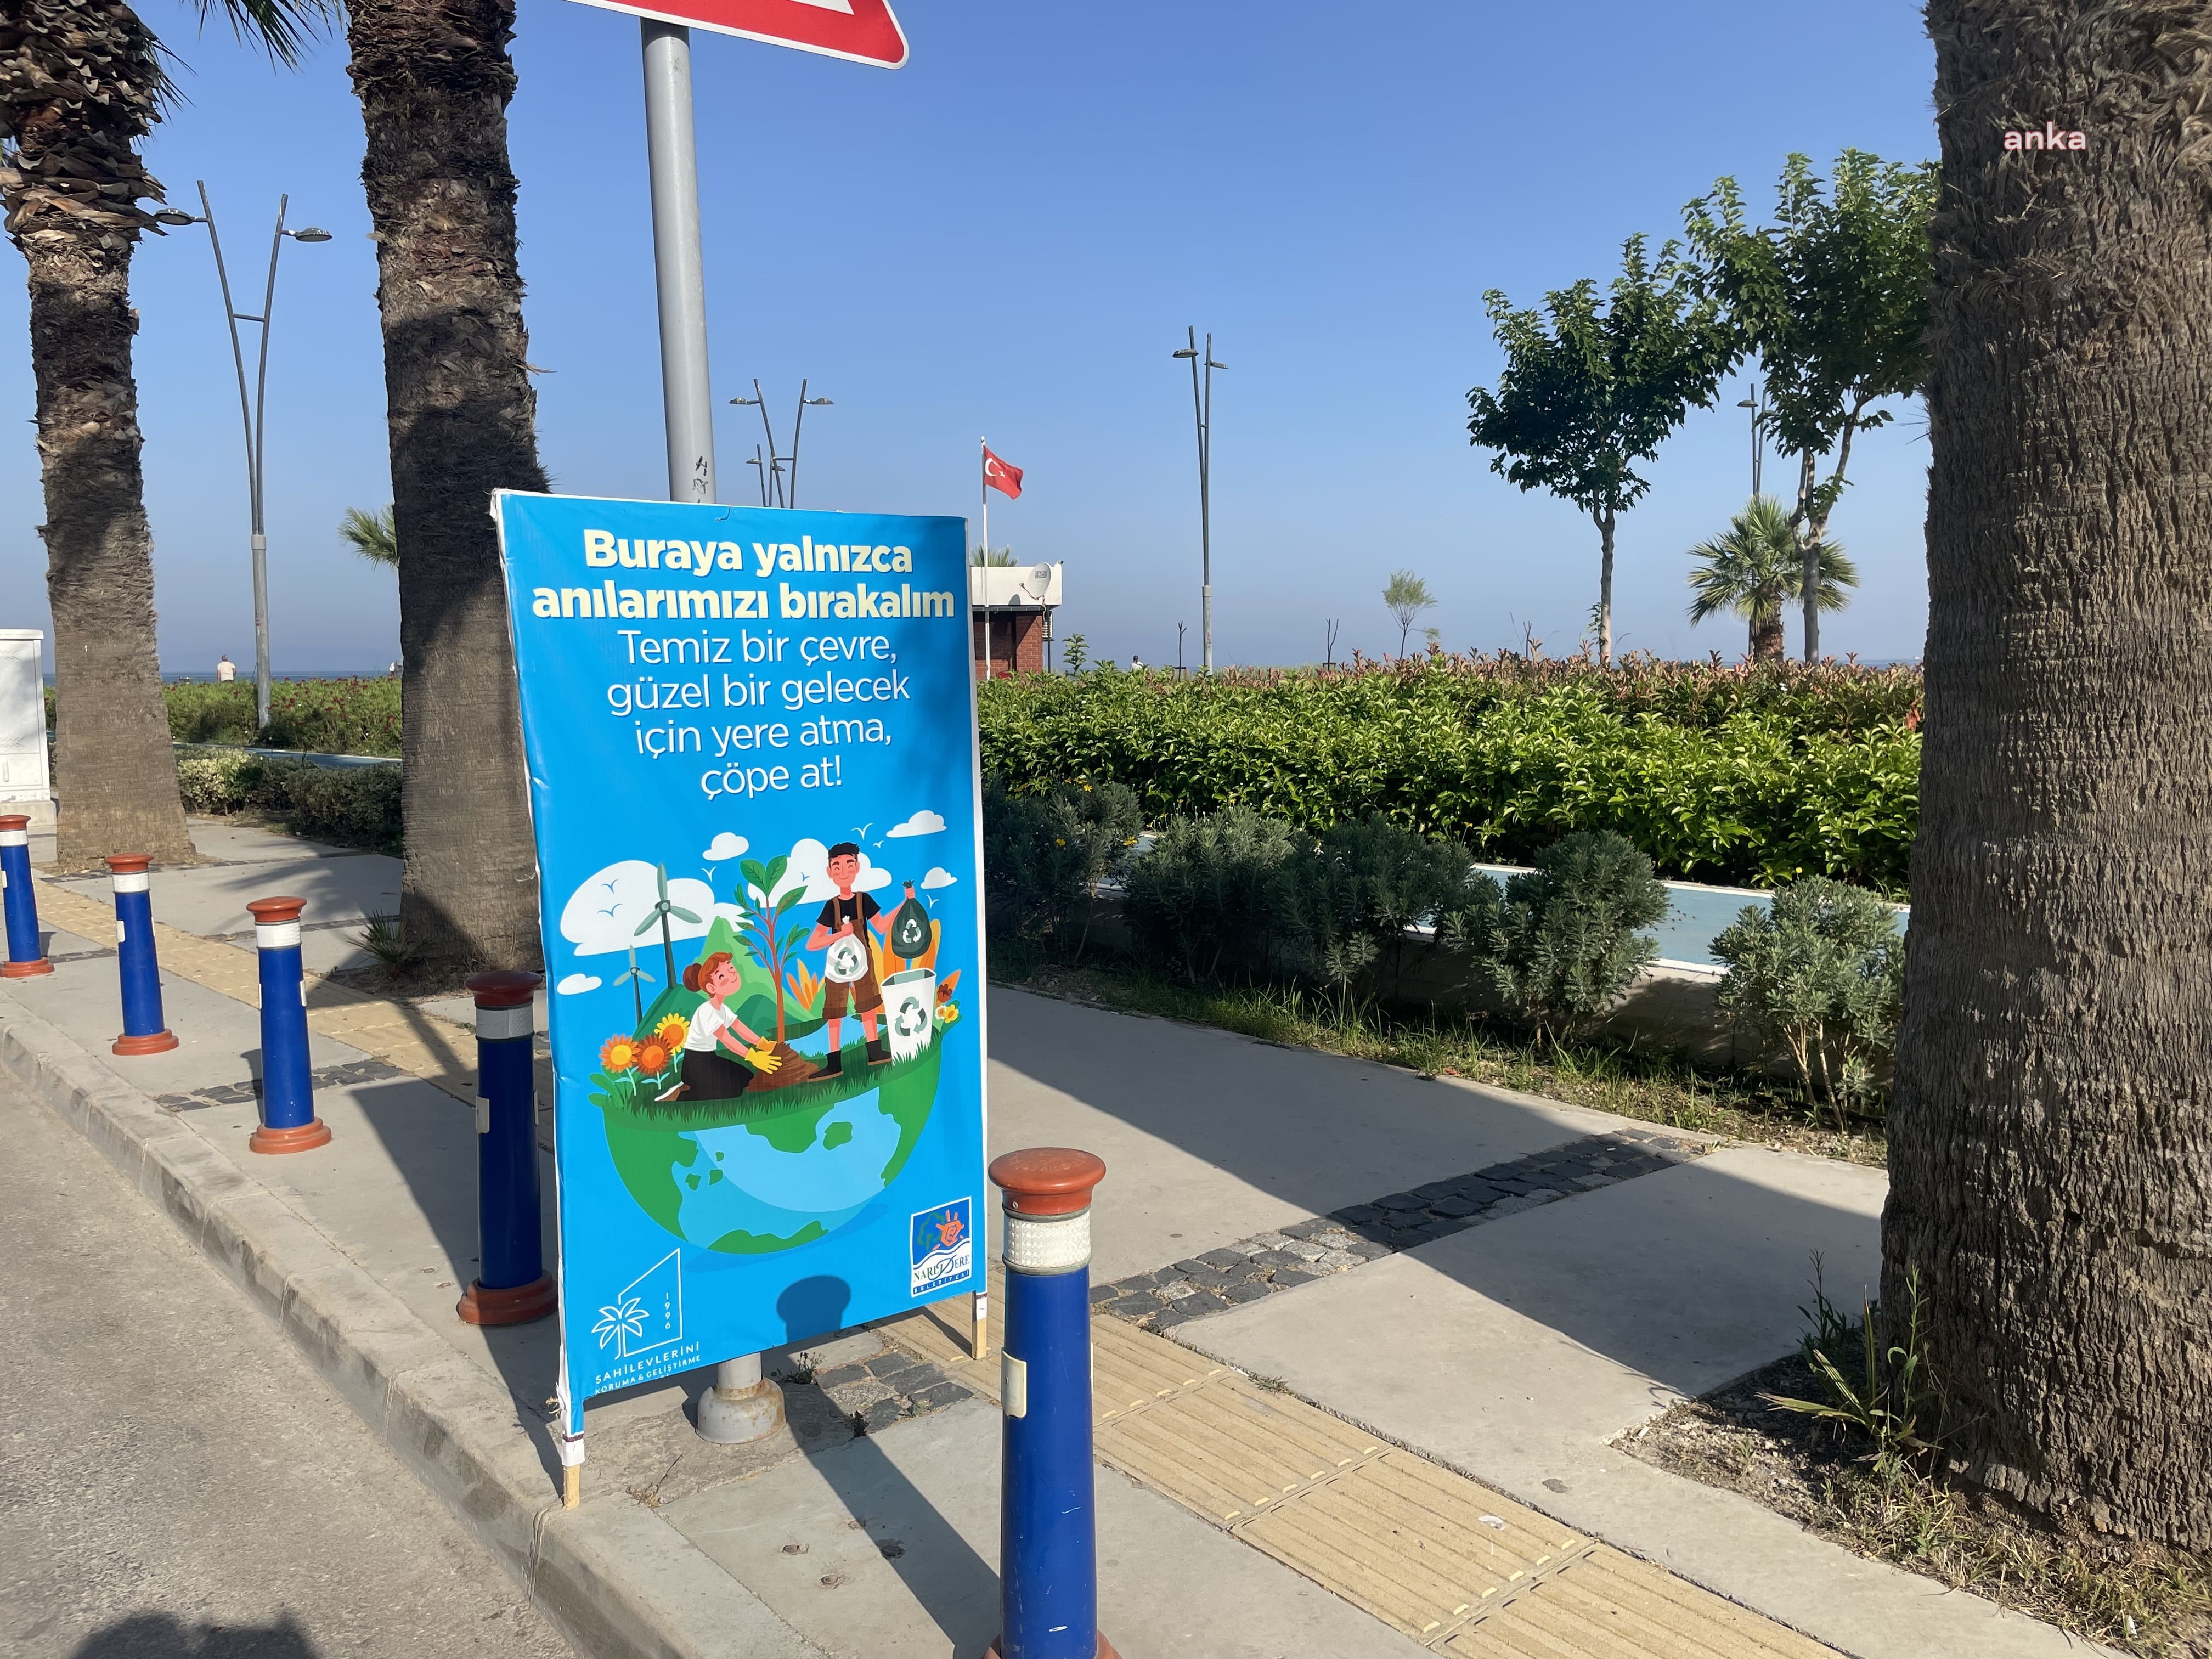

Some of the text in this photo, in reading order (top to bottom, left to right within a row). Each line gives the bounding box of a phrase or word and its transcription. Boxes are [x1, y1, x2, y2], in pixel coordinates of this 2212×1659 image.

[584, 529, 912, 578] Buraya yalnızca
[532, 579, 955, 619] anılarımızı bırakalım
[617, 629, 896, 667] Temiz bir çevre,
[607, 669, 910, 716] güzel bir gelecek
[635, 715, 891, 759] için yere atma,
[701, 755, 842, 800] çöpe at!
[595, 1377, 636, 1395] KORUMA
[646, 1355, 701, 1379] GELİŞTİRME
[596, 1341, 699, 1384] SAHİLEVLERİNİ
